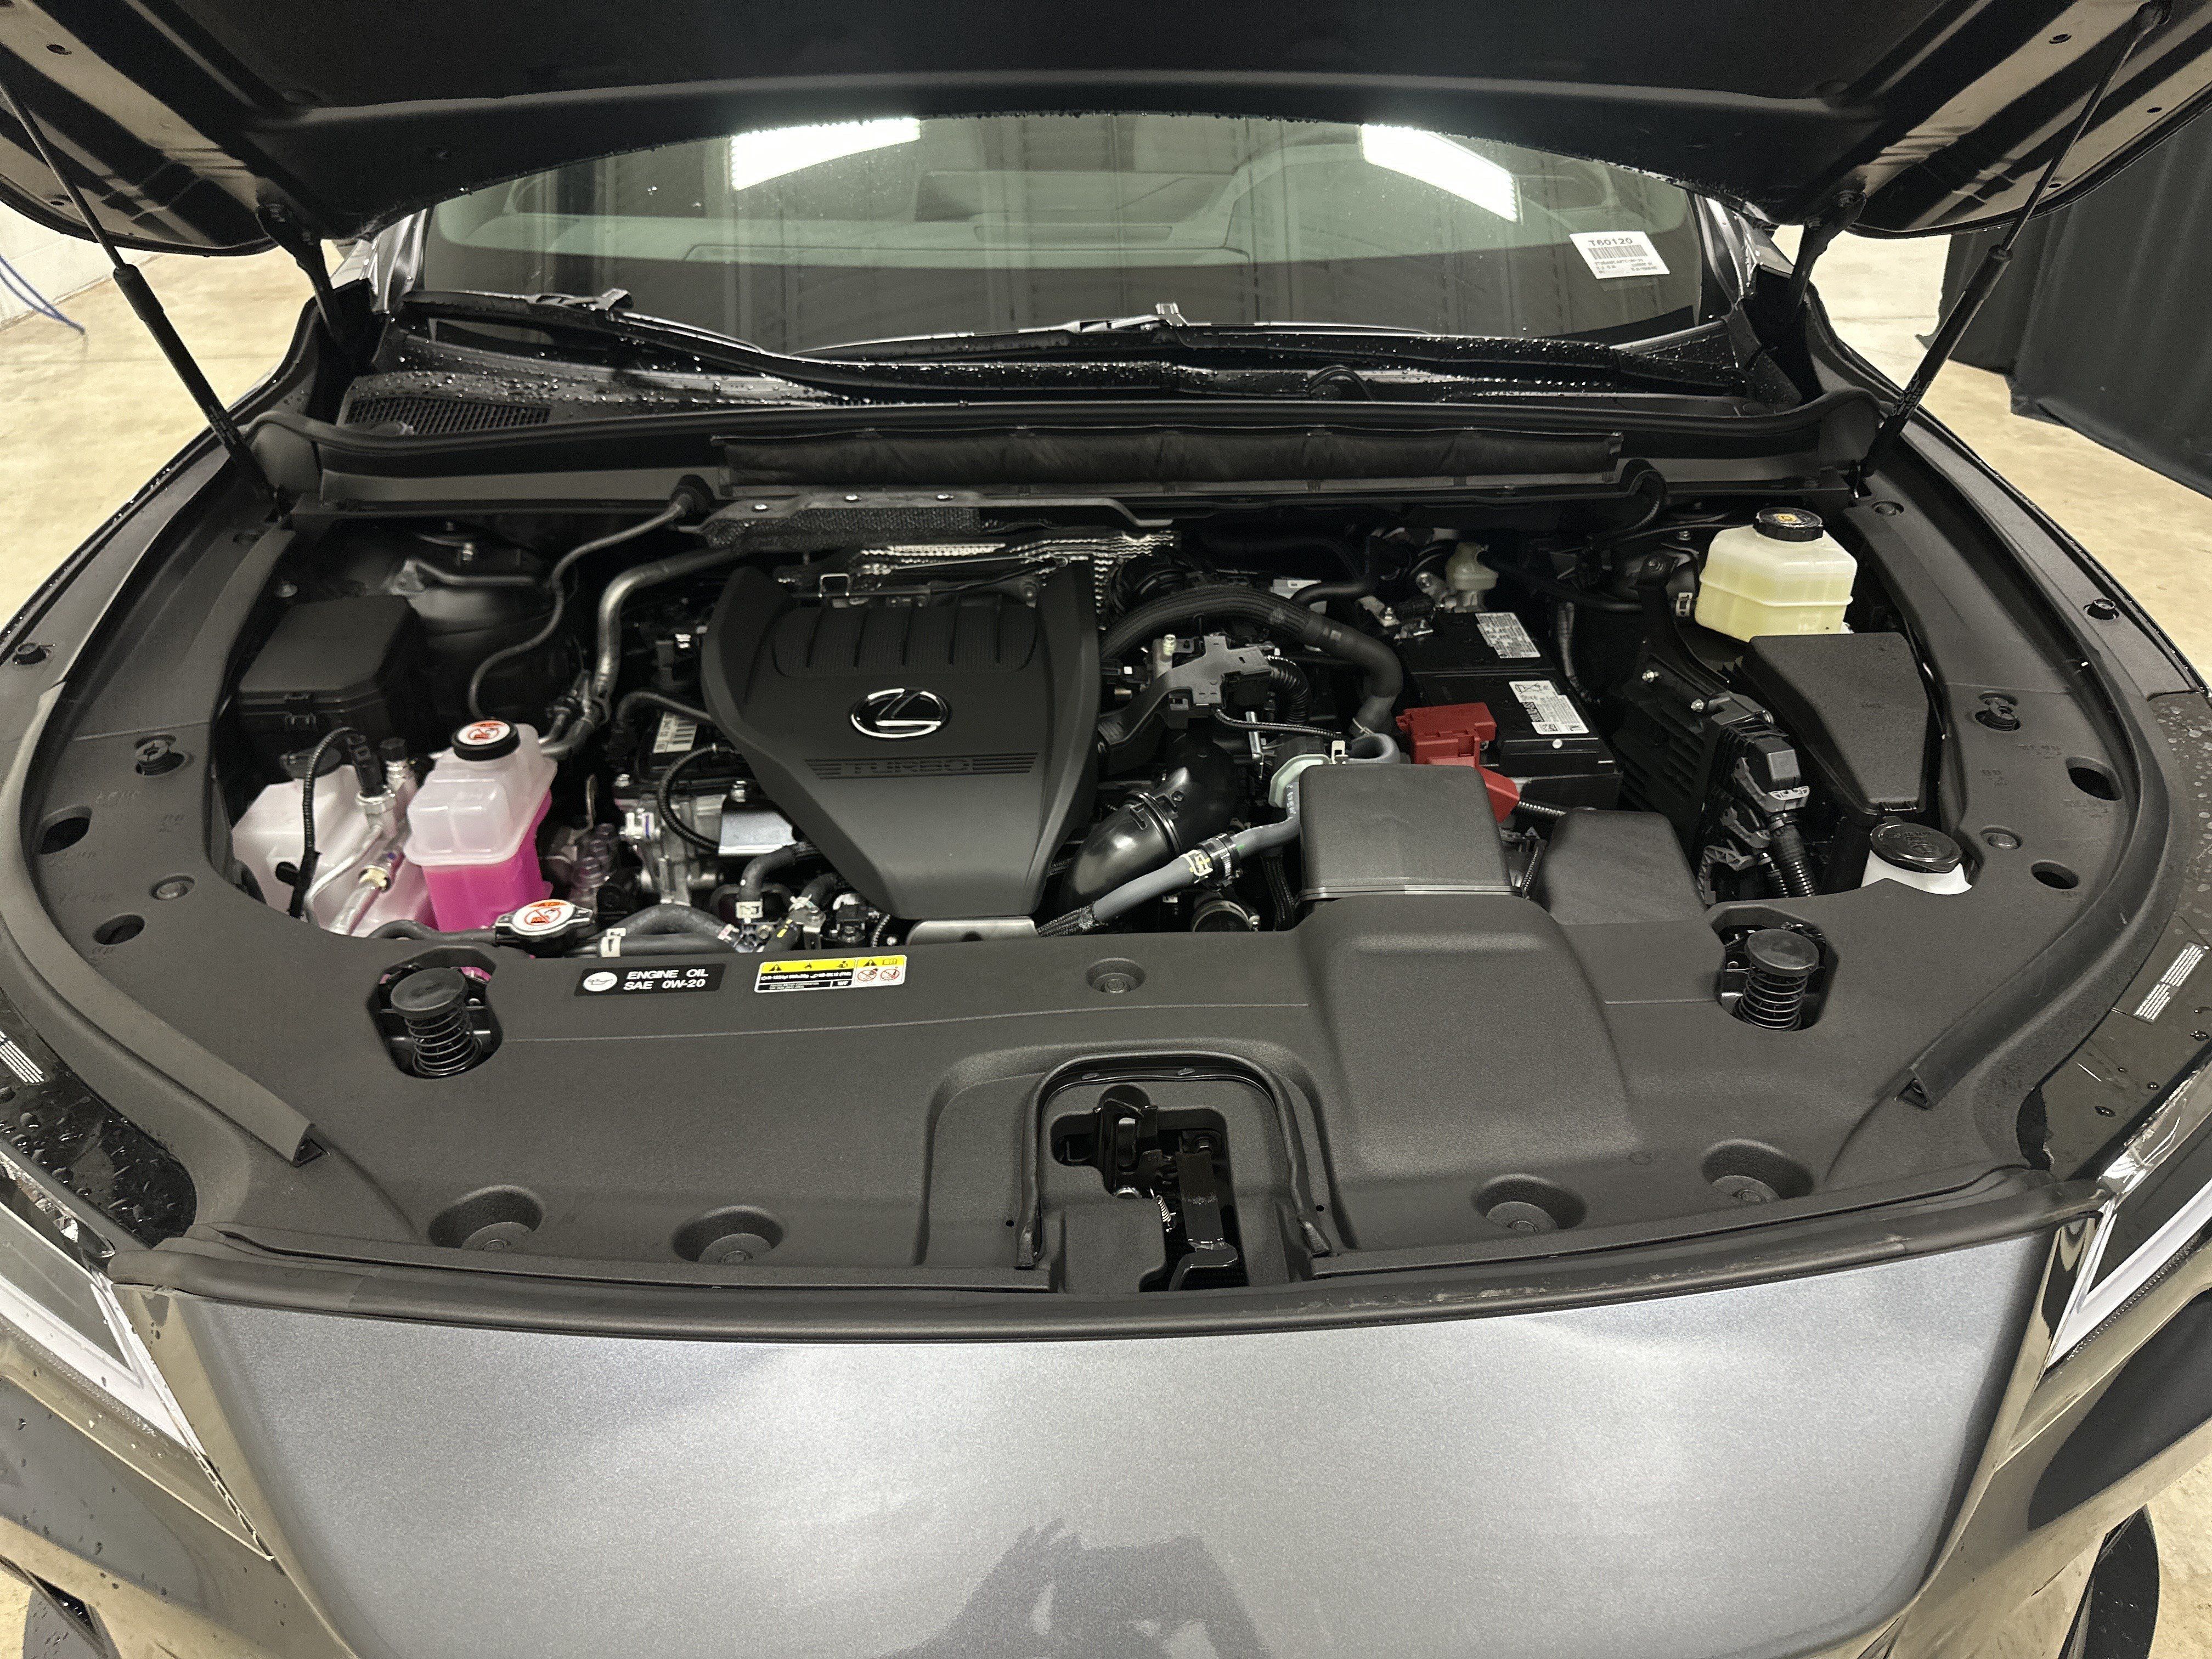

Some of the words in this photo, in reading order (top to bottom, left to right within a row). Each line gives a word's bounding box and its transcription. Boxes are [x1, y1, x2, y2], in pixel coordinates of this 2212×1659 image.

[1588, 238, 1633, 247] T60120
[842, 758, 973, 776] TURBO
[627, 969, 679, 980] ENGINE
[686, 968, 709, 978] OIL
[623, 980, 654, 990] SAE
[662, 979, 706, 989] 0W-20
